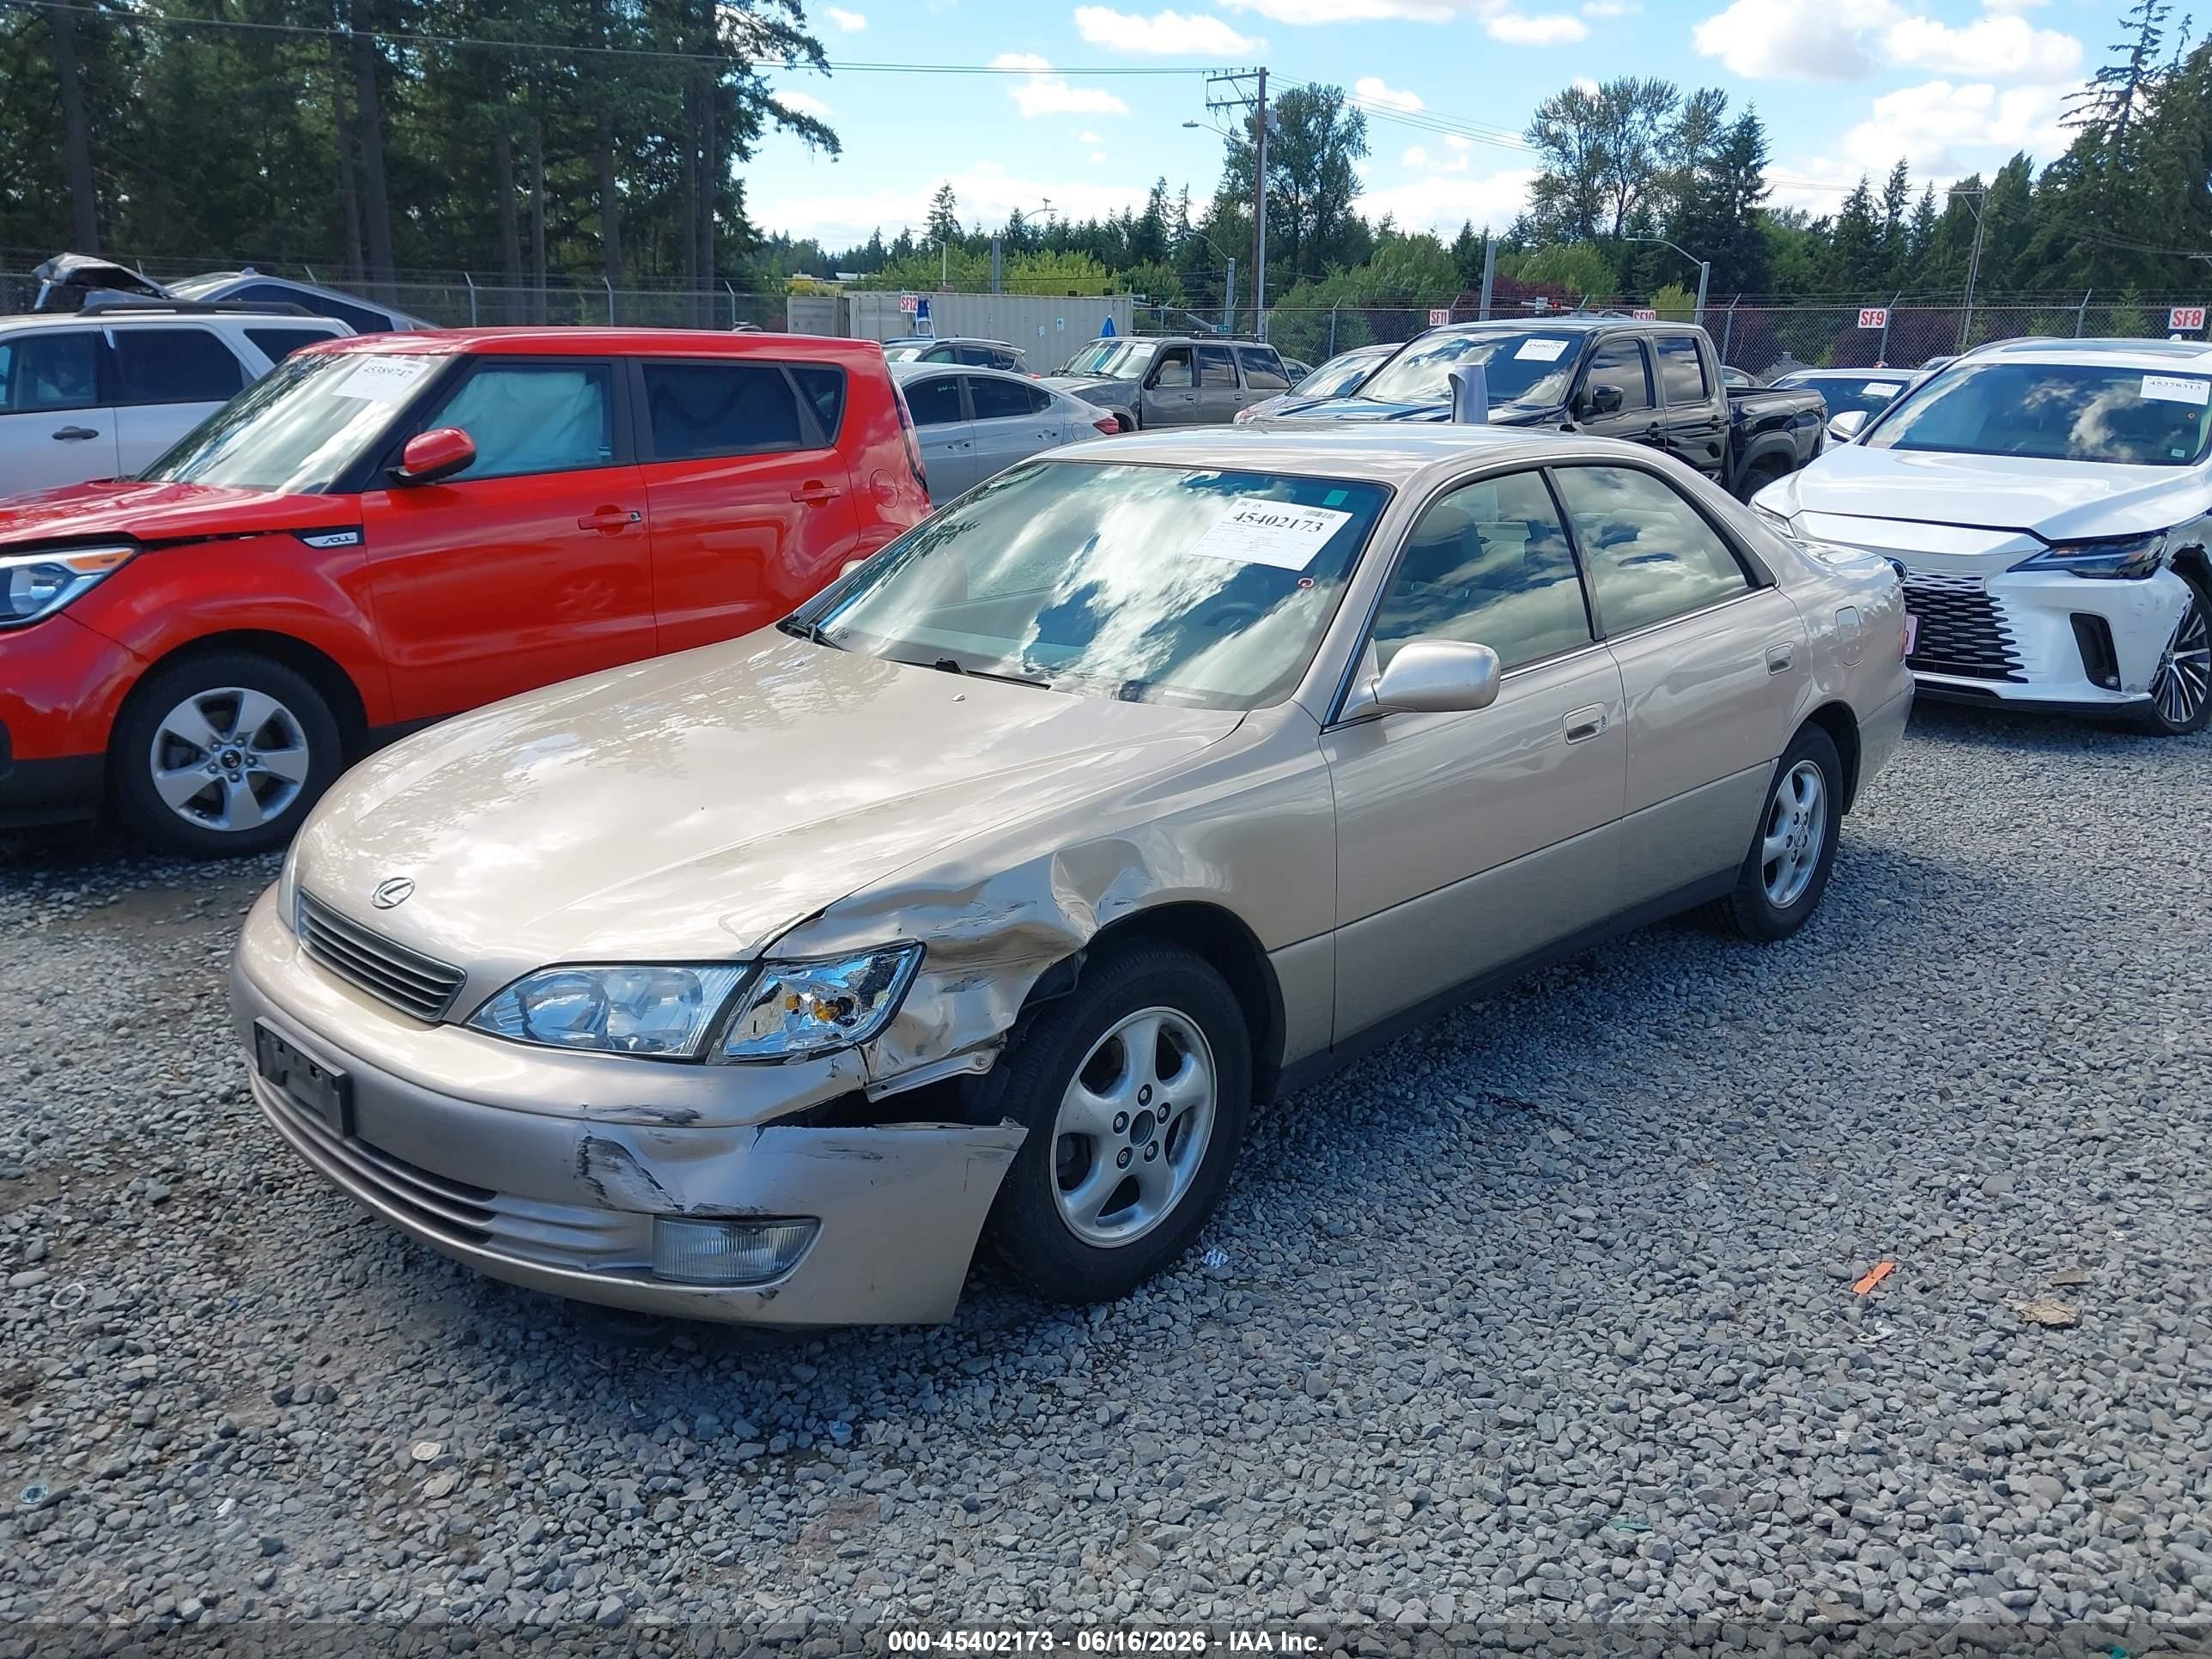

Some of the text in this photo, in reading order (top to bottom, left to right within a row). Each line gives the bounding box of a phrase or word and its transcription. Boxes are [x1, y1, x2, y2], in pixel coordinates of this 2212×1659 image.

[901, 296, 918, 311] SF12
[1431, 311, 1448, 325] SF11
[1861, 311, 1885, 326] SF9
[2172, 309, 2203, 327] SF8
[1232, 511, 1325, 533] 45402173
